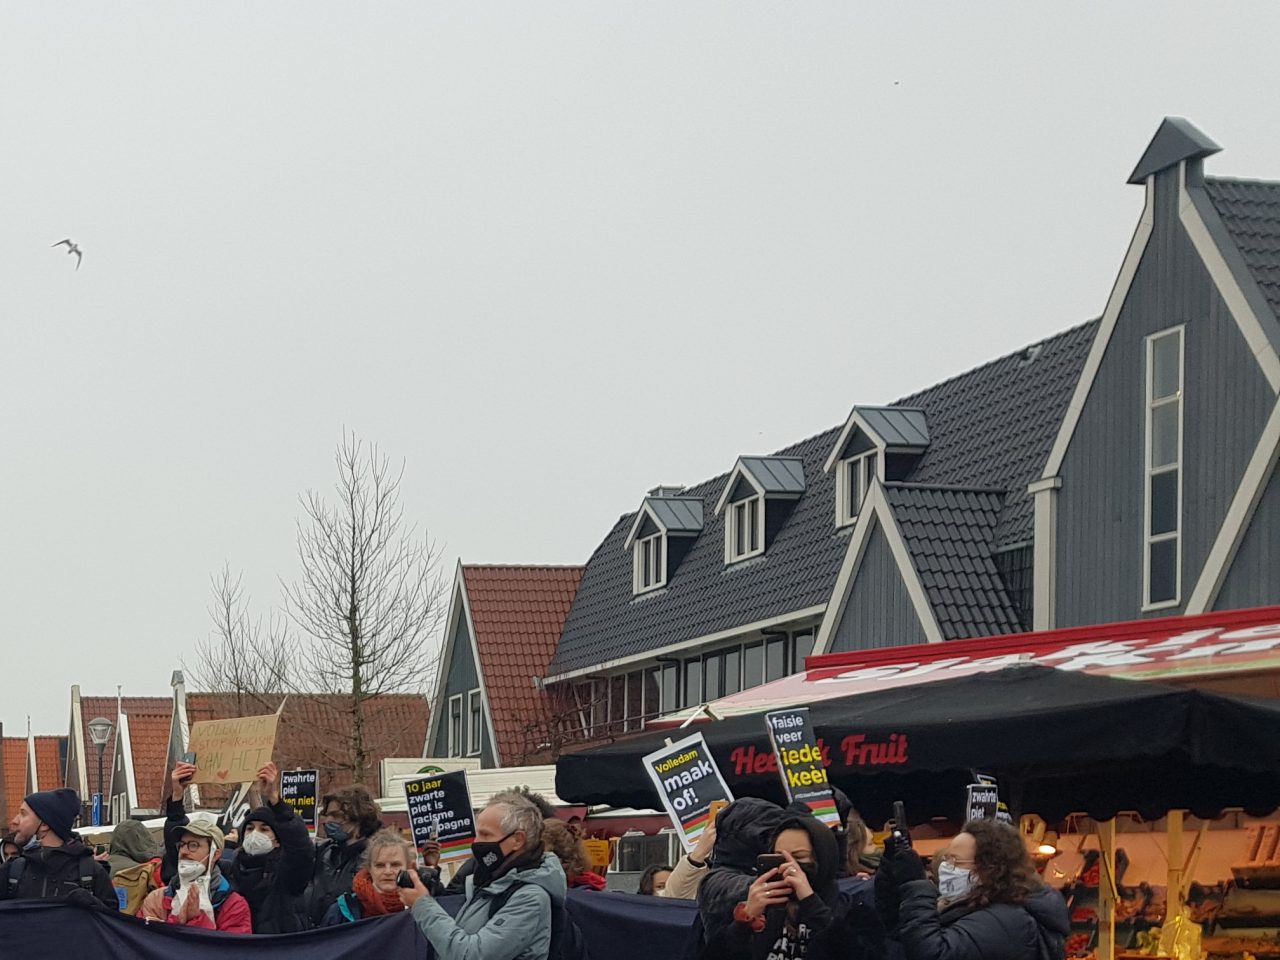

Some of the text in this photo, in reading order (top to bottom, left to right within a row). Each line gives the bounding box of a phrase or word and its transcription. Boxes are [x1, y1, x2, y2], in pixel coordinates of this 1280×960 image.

[775, 730, 803, 744] veer
[840, 733, 909, 766] Fruit
[663, 760, 713, 793] maak
[283, 785, 297, 796] piet
[406, 779, 442, 793] 10 jaar
[297, 795, 315, 806] niet
[408, 789, 445, 804] zwarte
[673, 787, 699, 810] of!
[410, 800, 444, 816] piet is
[412, 810, 454, 825] racisme
